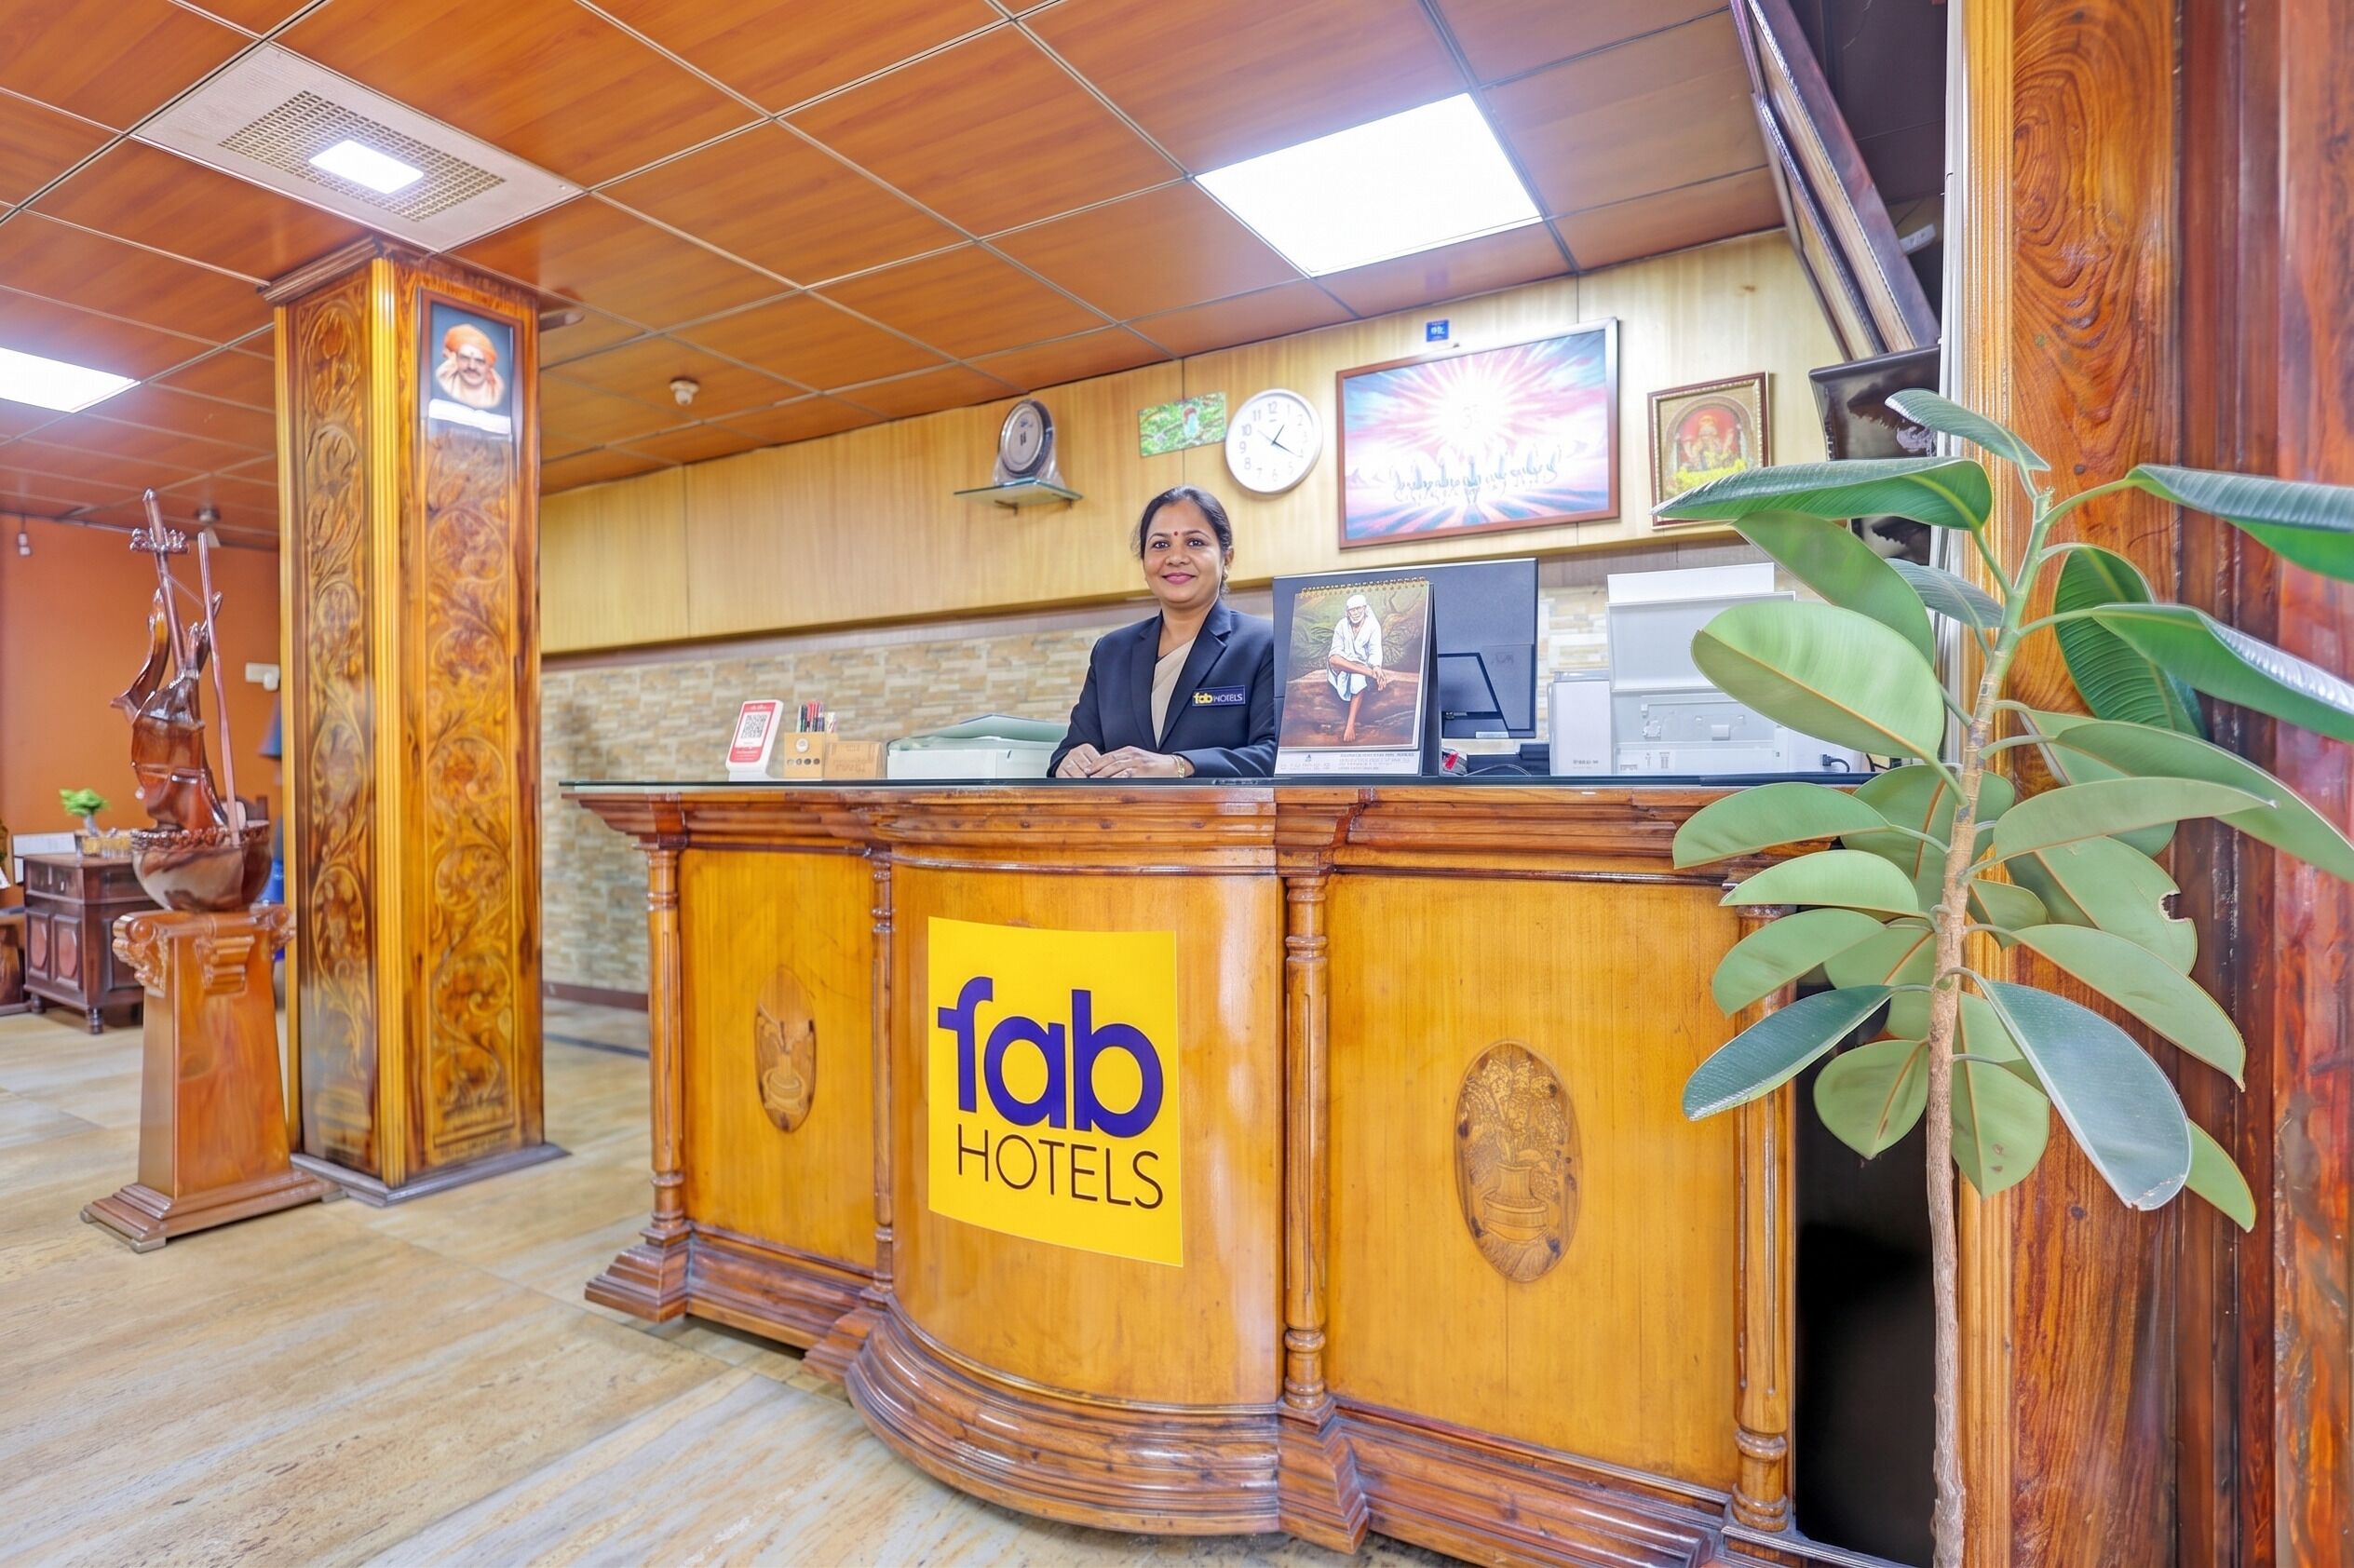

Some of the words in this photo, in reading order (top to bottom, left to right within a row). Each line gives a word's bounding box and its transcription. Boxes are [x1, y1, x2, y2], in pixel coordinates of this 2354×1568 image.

[1267, 400, 1278, 414] 12
[1252, 409, 1262, 422] 11
[1297, 413, 1304, 426] 2
[1240, 424, 1252, 437] 10
[1238, 440, 1247, 454] 9
[1244, 457, 1251, 470] 8
[1193, 692, 1213, 704] fab
[1213, 693, 1243, 703] HOTELS
[938, 975, 1164, 1139] fab
[958, 1123, 1163, 1210] HOTELS
